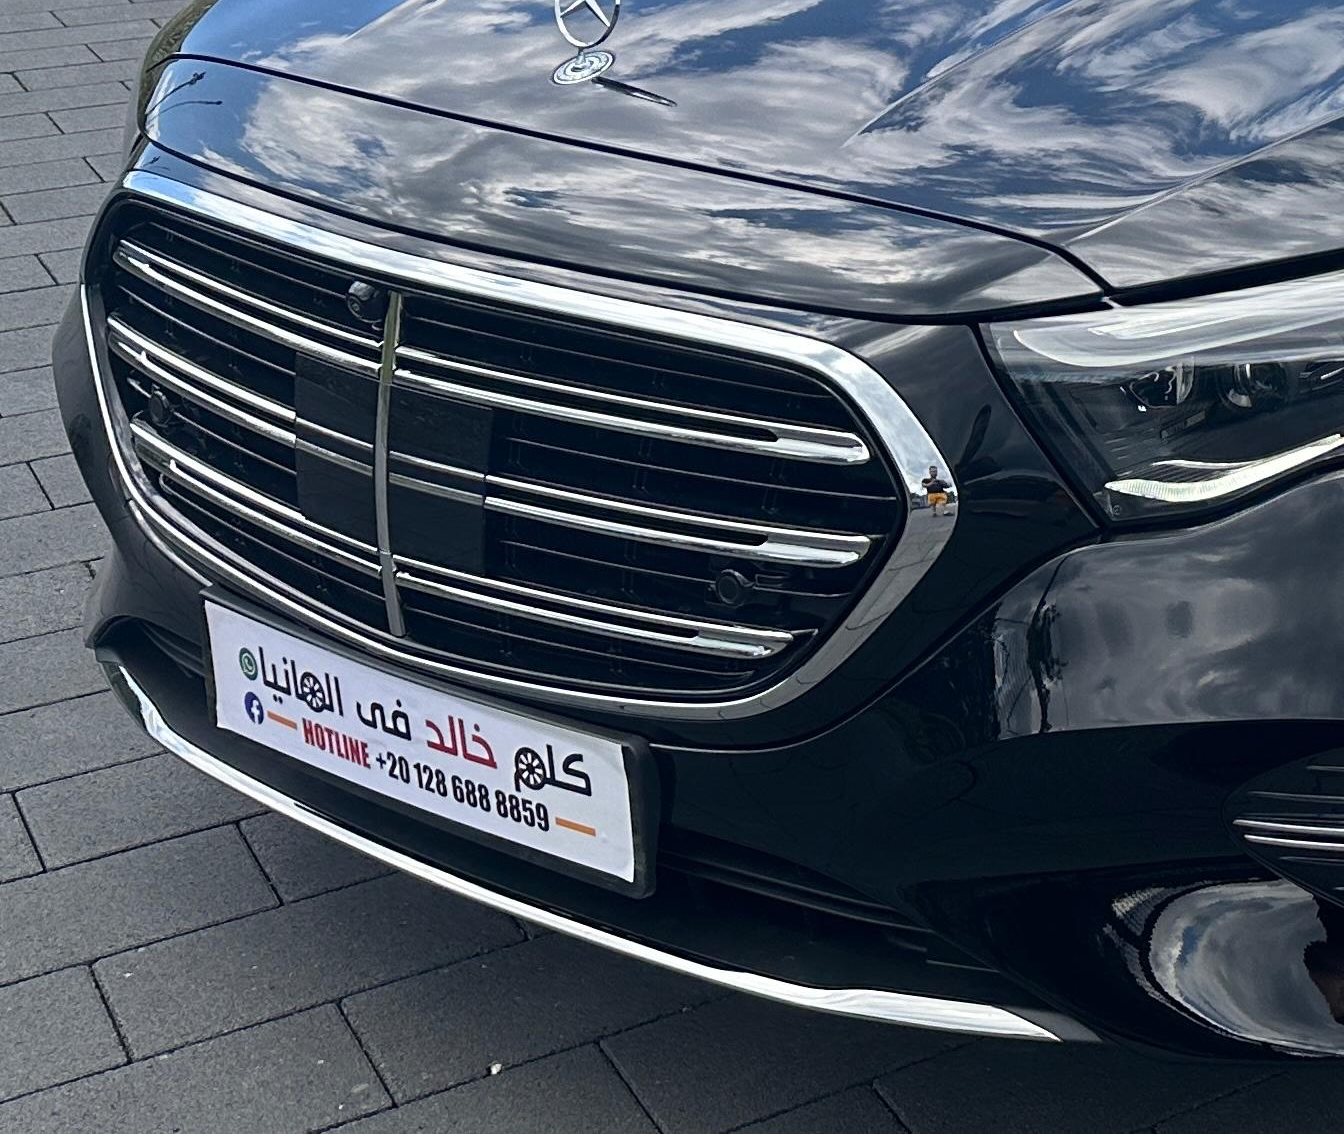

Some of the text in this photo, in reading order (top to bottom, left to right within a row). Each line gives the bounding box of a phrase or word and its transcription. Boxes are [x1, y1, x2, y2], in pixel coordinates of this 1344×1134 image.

[425, 715, 498, 769] خالد
[302, 717, 550, 833] HOTLINE +20 128 688 8859
[514, 744, 593, 797] كلم
